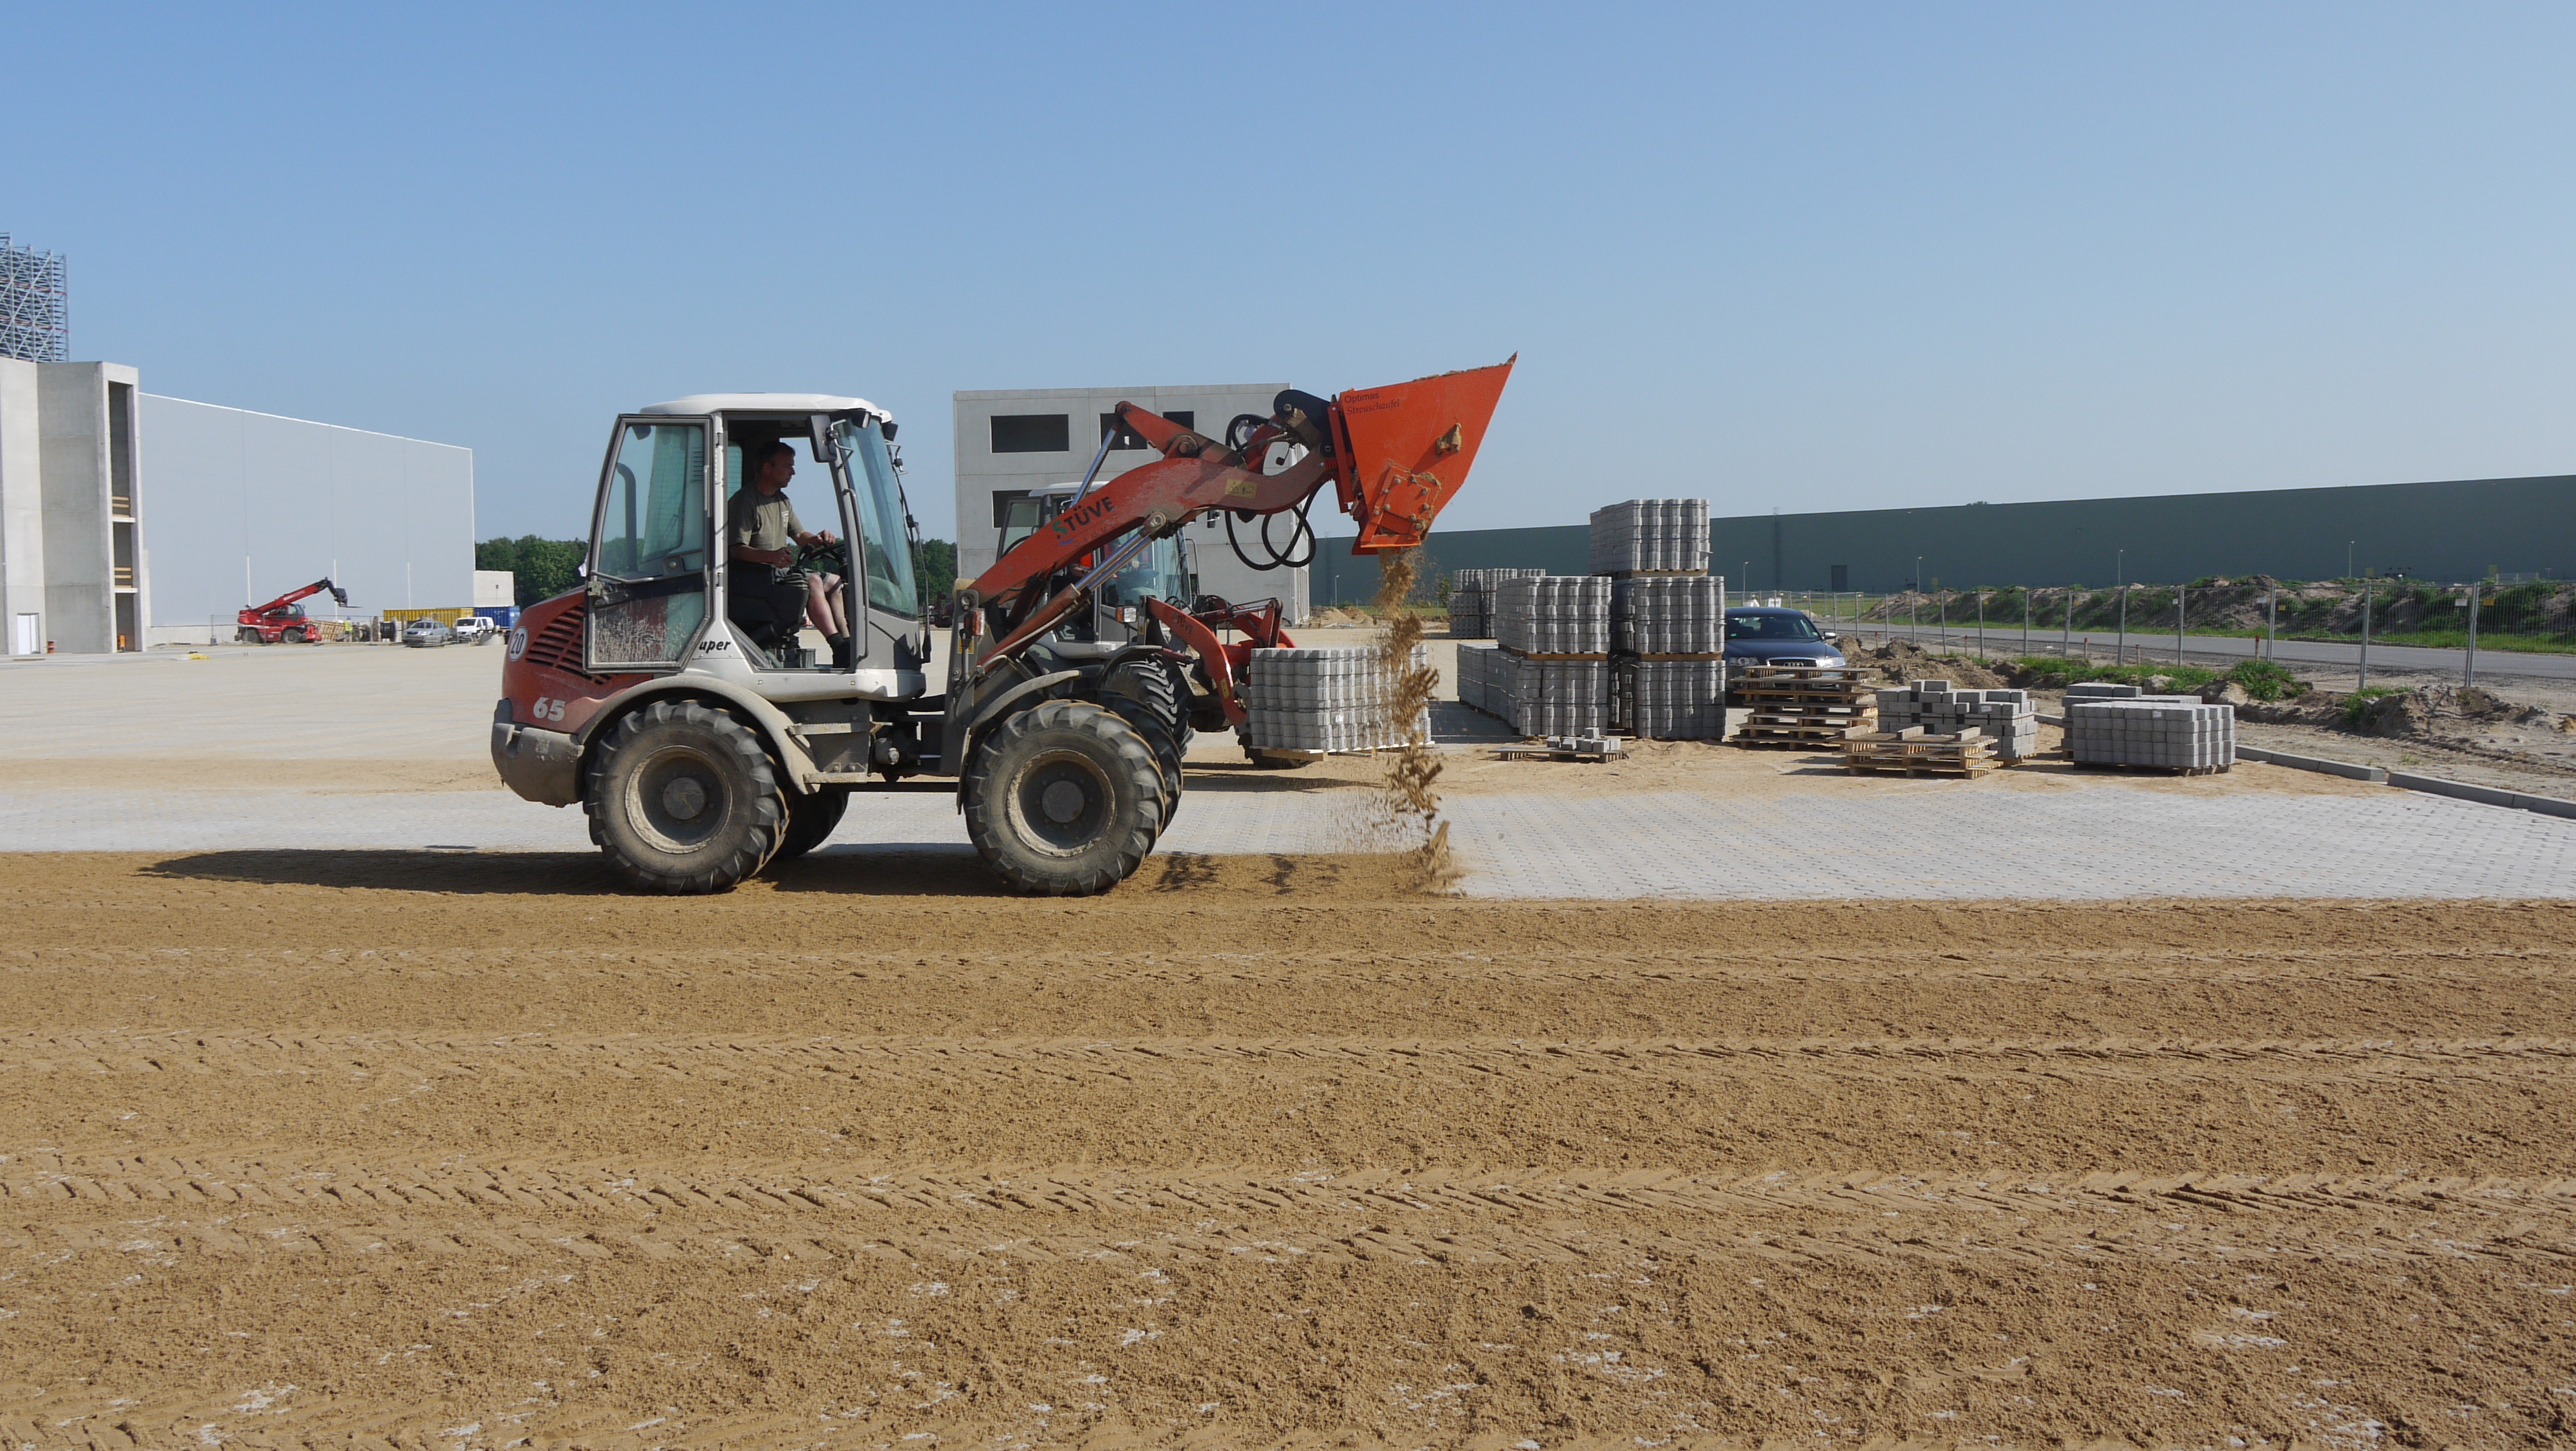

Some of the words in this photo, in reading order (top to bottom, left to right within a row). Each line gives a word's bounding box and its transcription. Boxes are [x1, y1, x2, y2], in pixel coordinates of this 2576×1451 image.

[1344, 392, 1380, 404] Optimas
[1347, 398, 1401, 414] Streuschaufel
[1052, 496, 1115, 537] STÜVE
[510, 633, 524, 654] 20
[698, 640, 731, 654] uper
[533, 696, 566, 722] 65
